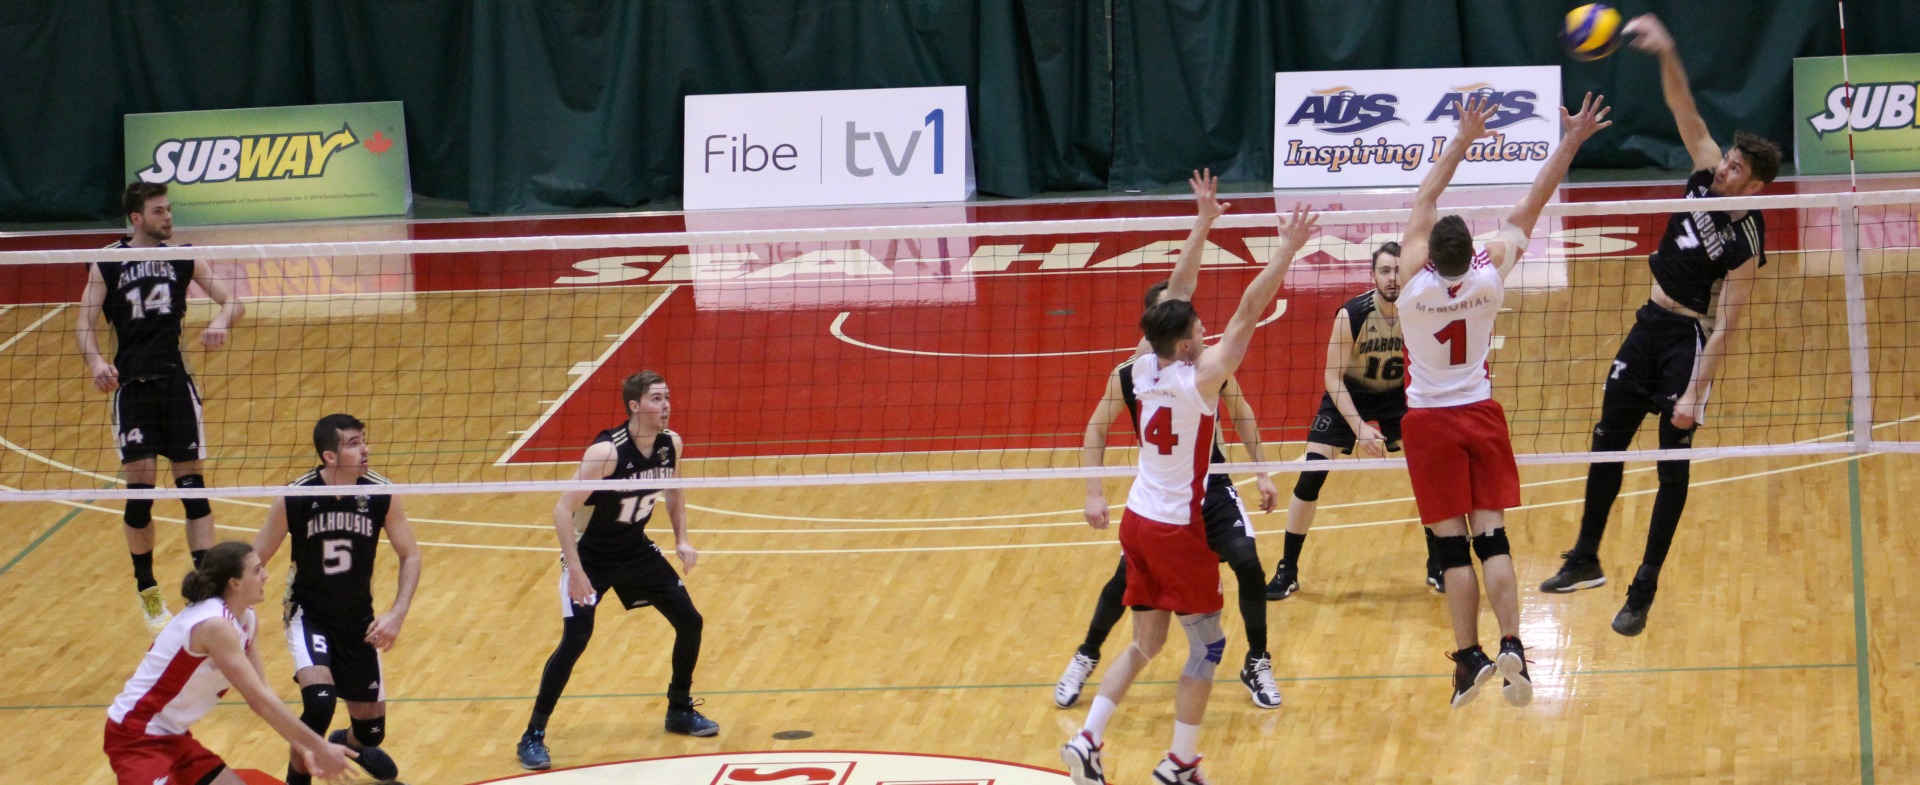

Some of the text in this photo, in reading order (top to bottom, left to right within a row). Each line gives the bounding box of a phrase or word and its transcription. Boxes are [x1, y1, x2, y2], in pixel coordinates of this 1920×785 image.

[1286, 93, 1402, 131] AUS
[1806, 81, 1920, 140] SUB
[135, 122, 359, 185] SUBWAY
[704, 108, 944, 178] Fibe tv1
[1284, 134, 1549, 172] Inspiring Laders
[1675, 217, 1700, 251] 7
[554, 226, 1640, 284] SEA-HAWS
[125, 282, 172, 320] 14
[1416, 295, 1490, 313] MEMORIAL
[1360, 336, 1404, 355] DALHOU
[1433, 318, 1467, 366] 1
[1363, 355, 1405, 380] 16
[1610, 359, 1628, 379] 7
[120, 427, 144, 448] 14
[1144, 405, 1179, 456] 4
[1311, 414, 1332, 432] 16
[307, 511, 374, 540] DALHOUSIE
[322, 538, 353, 575] 5
[312, 633, 328, 654] 5
